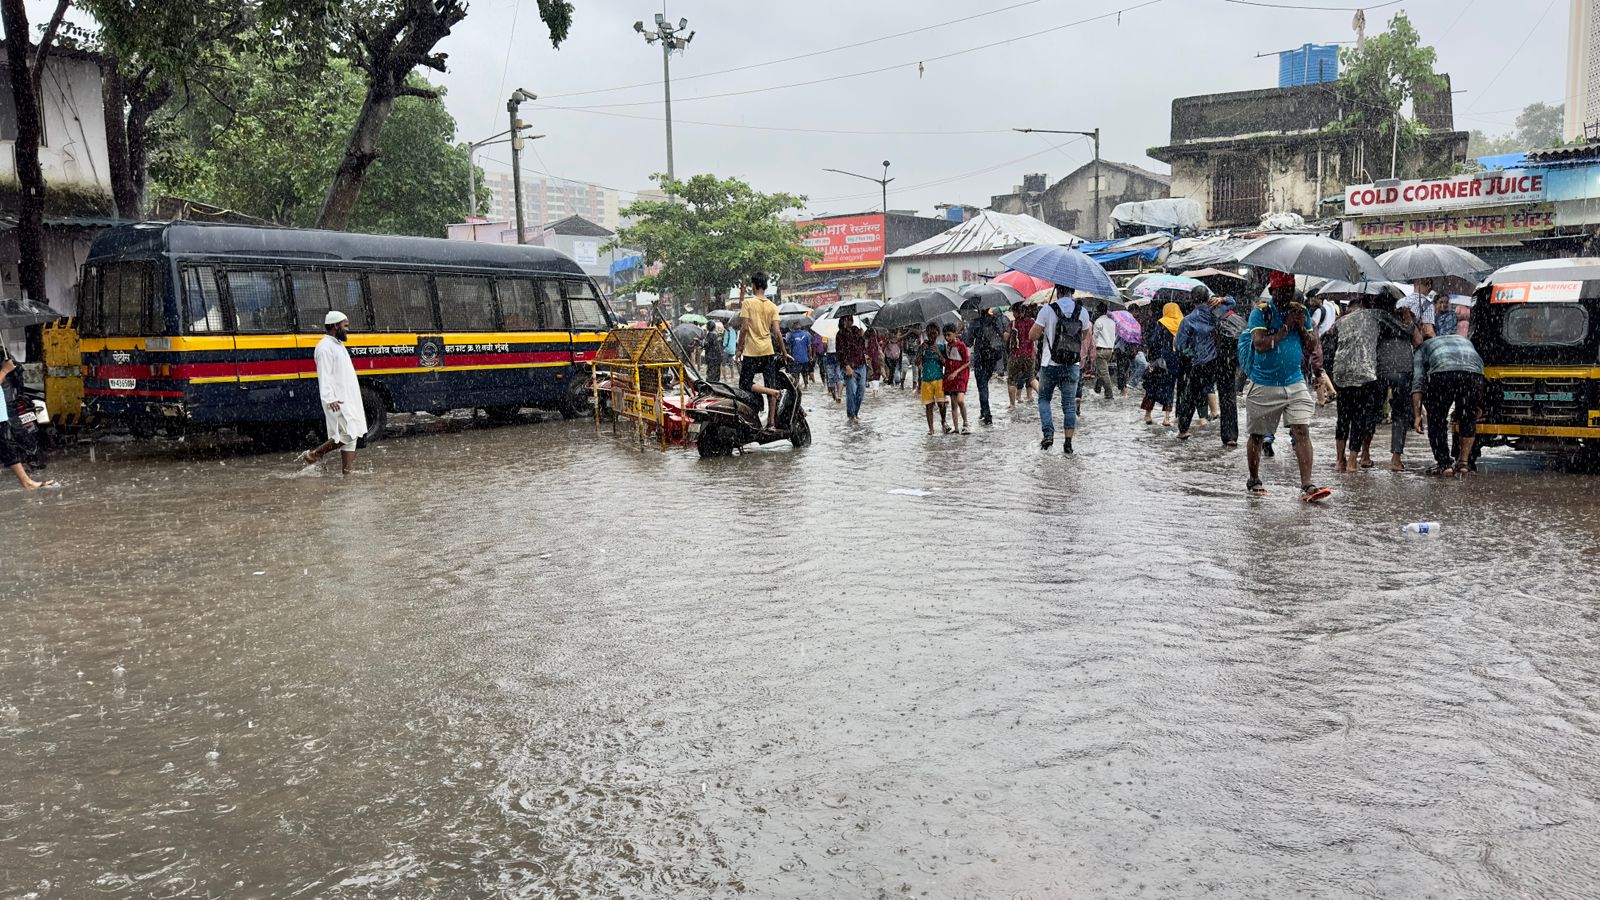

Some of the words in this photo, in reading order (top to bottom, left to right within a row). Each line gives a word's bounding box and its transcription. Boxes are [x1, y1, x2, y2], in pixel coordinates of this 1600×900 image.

[1350, 188, 1398, 206] COLD
[1403, 178, 1481, 202] CORNER
[1486, 175, 1544, 196] JUICE
[814, 245, 849, 256] HALIMAR
[850, 246, 881, 254] RESTAURANT
[392, 344, 415, 354] पोलीस
